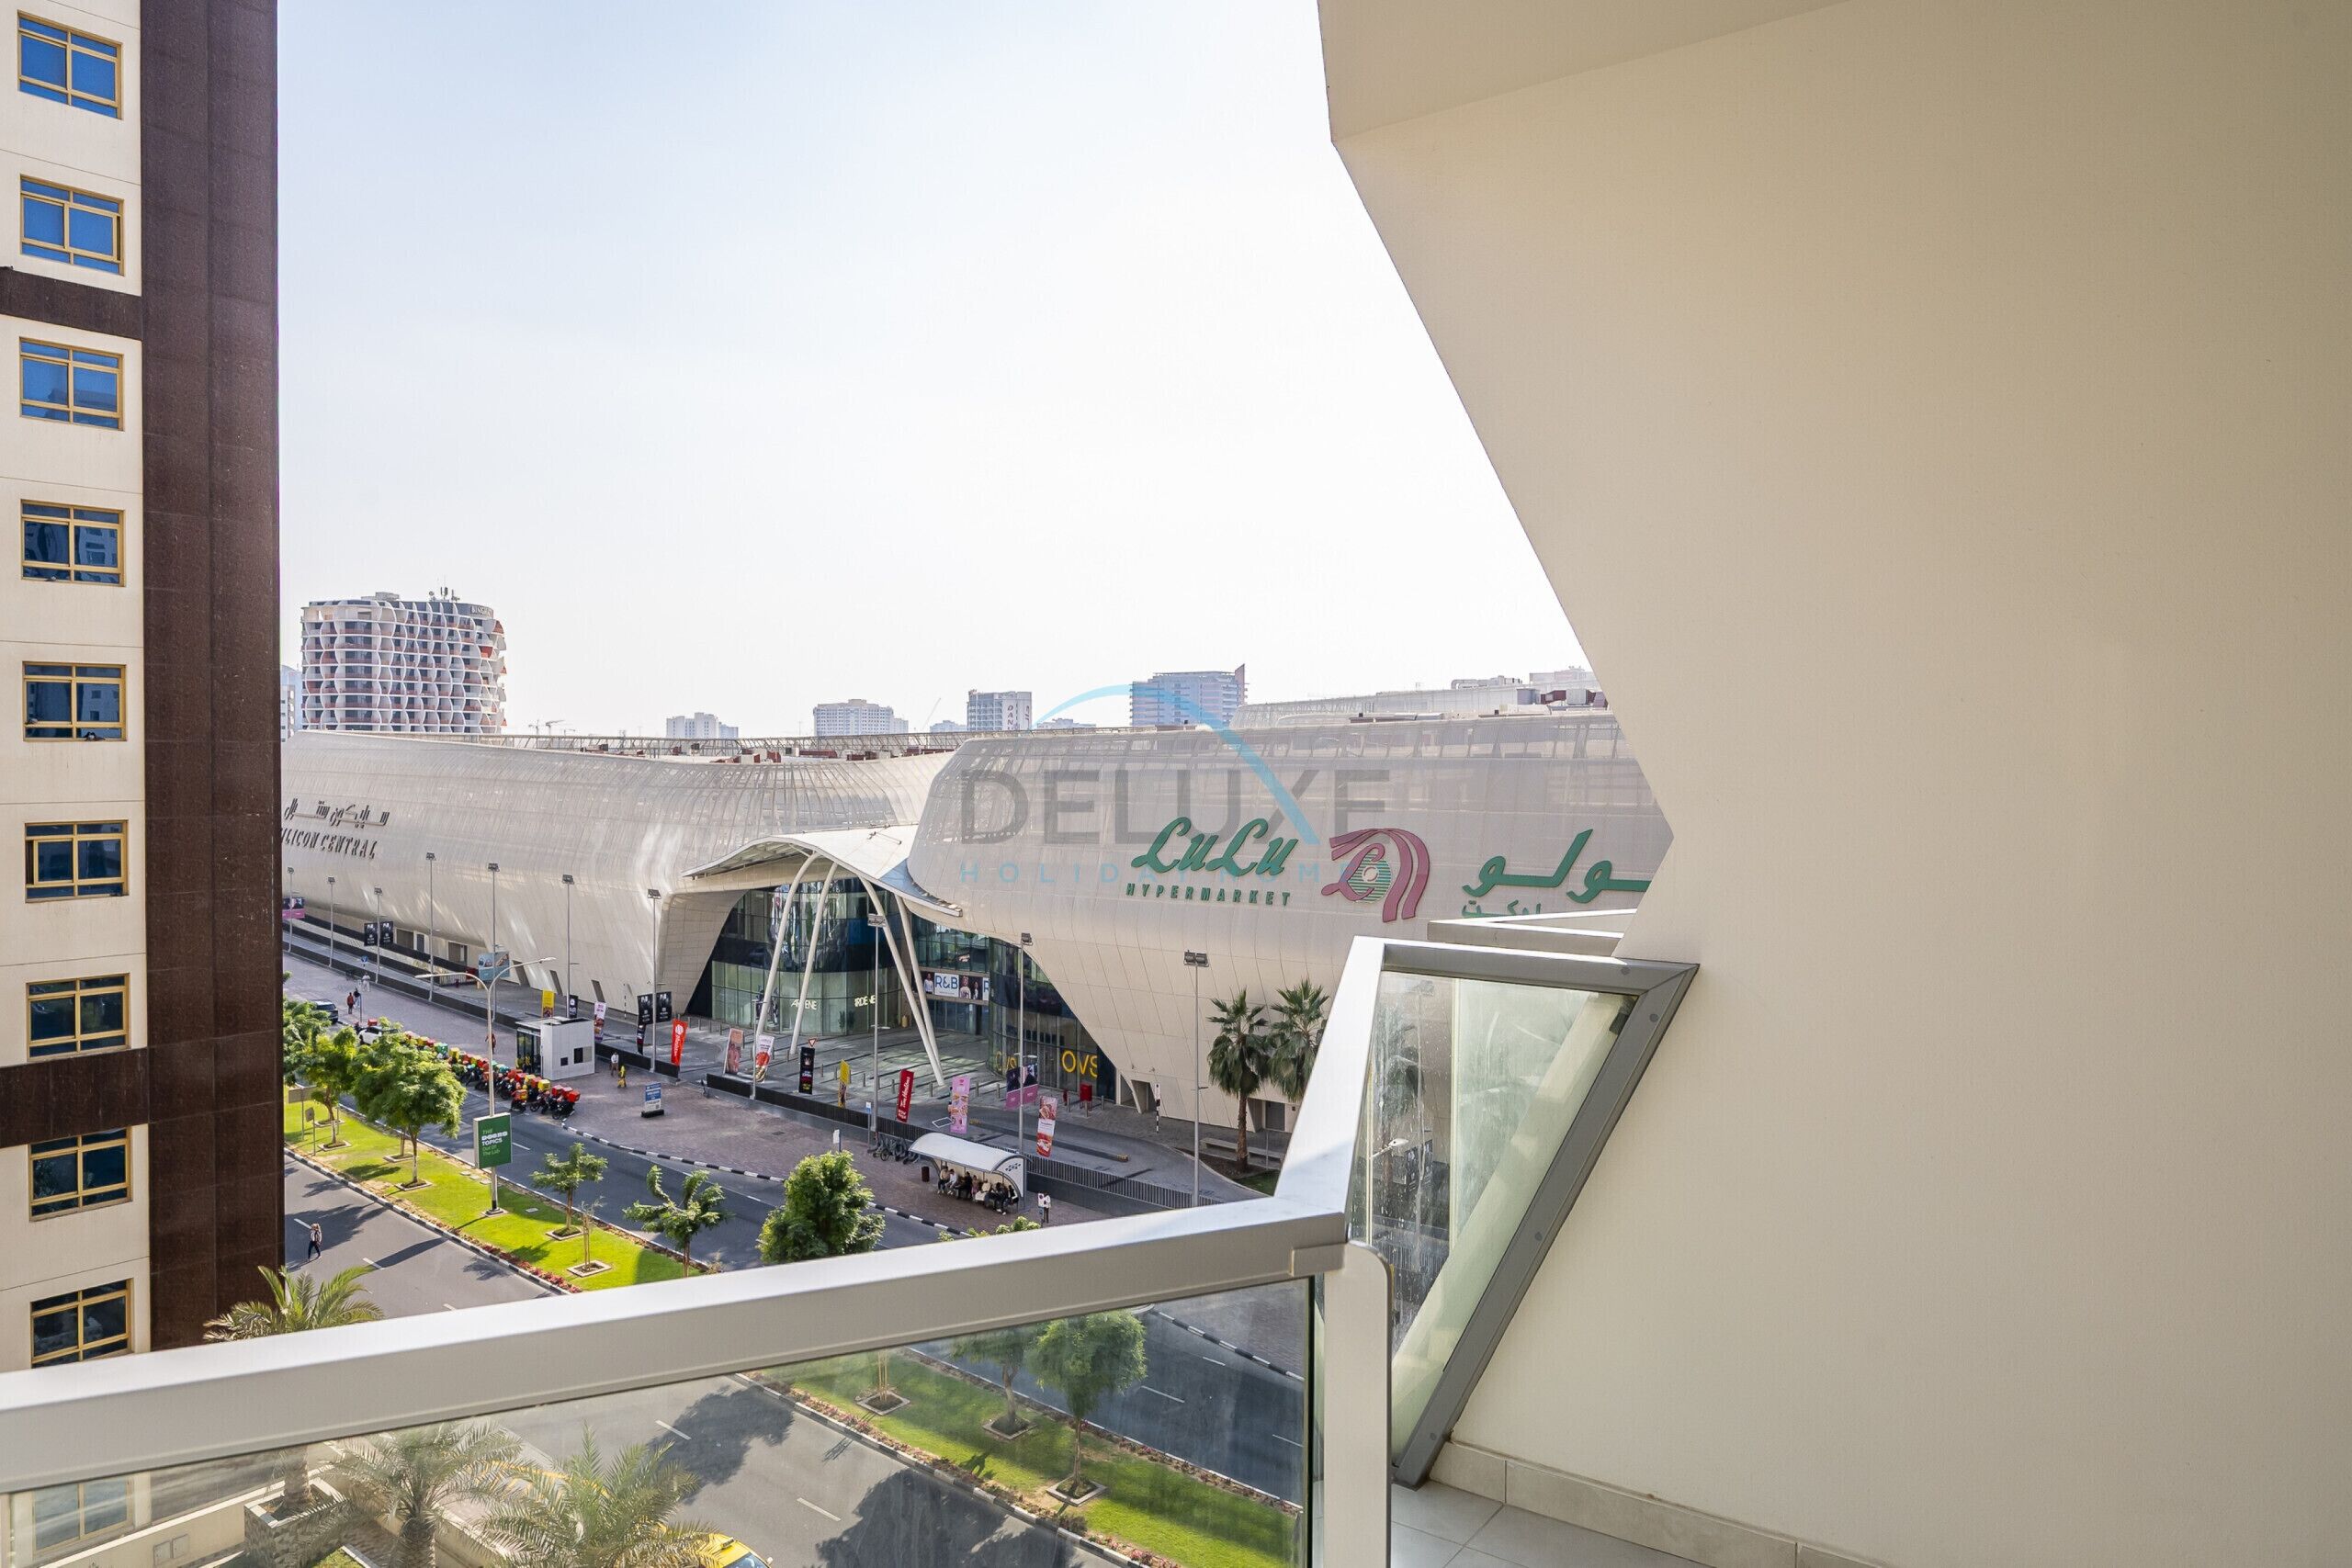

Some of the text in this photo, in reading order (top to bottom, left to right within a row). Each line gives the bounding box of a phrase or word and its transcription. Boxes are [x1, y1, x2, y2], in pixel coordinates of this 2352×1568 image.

[280, 828, 378, 860] ILICON CENTRAL
[1462, 829, 1652, 904] ولو
[1125, 883, 1291, 907] HYPERMARKET
[934, 975, 958, 989] R&B
[790, 998, 818, 1010] AENE
[1062, 1050, 1098, 1078] OVS
